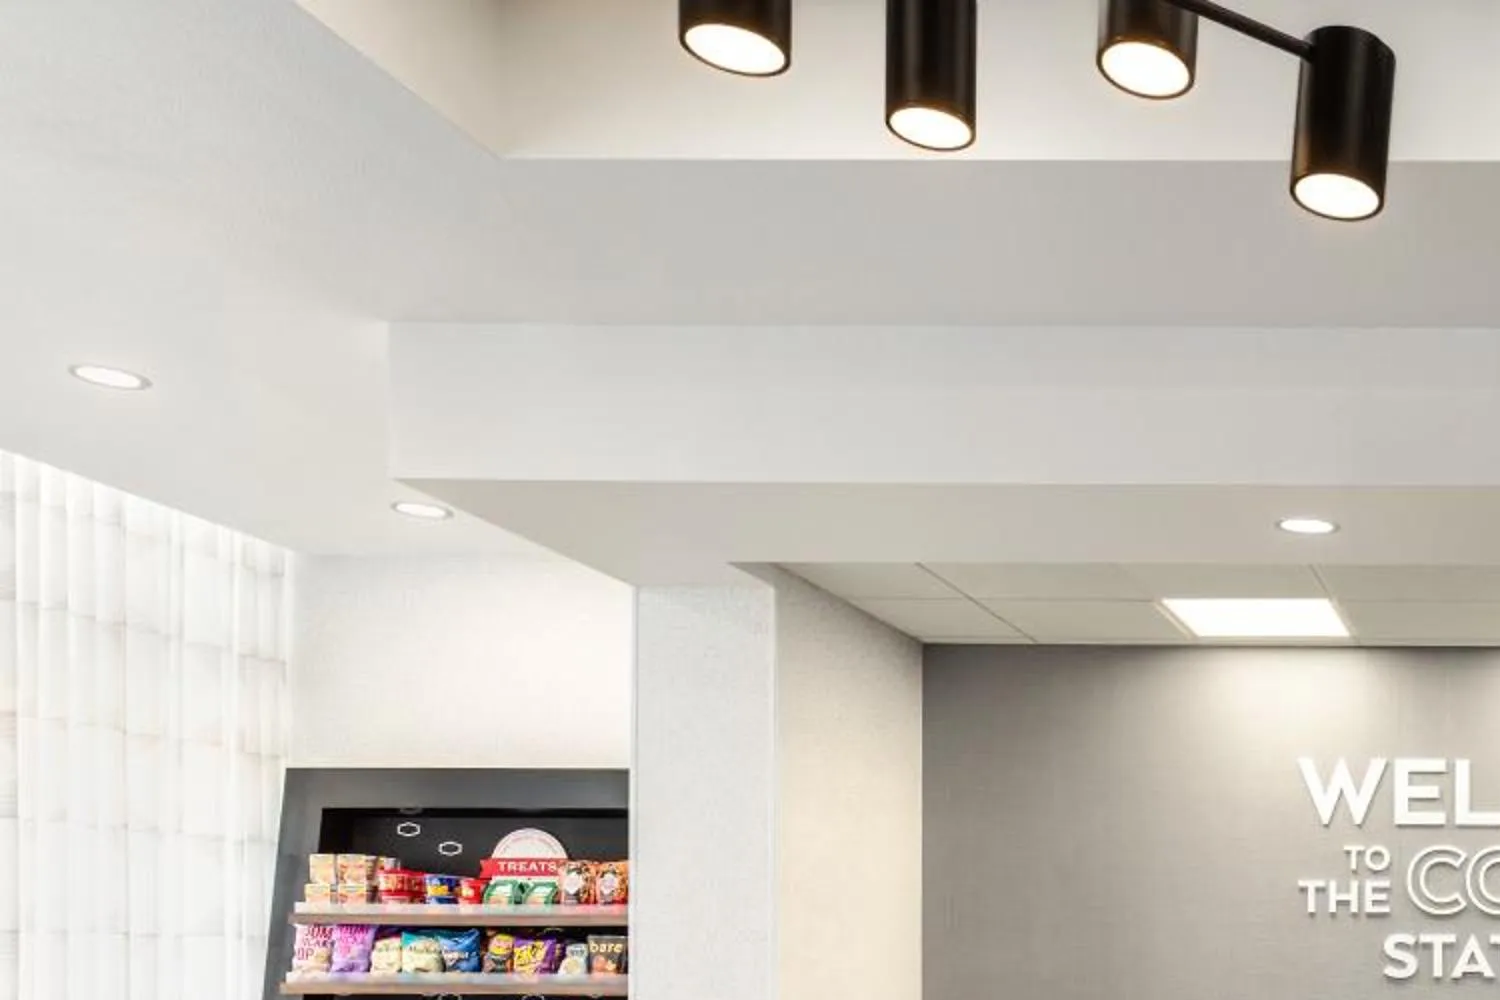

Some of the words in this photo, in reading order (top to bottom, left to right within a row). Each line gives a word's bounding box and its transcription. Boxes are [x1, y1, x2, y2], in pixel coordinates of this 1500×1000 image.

[498, 861, 557, 873] TREATS
[1343, 845, 1391, 872] TO
[1298, 879, 1391, 915] THE
